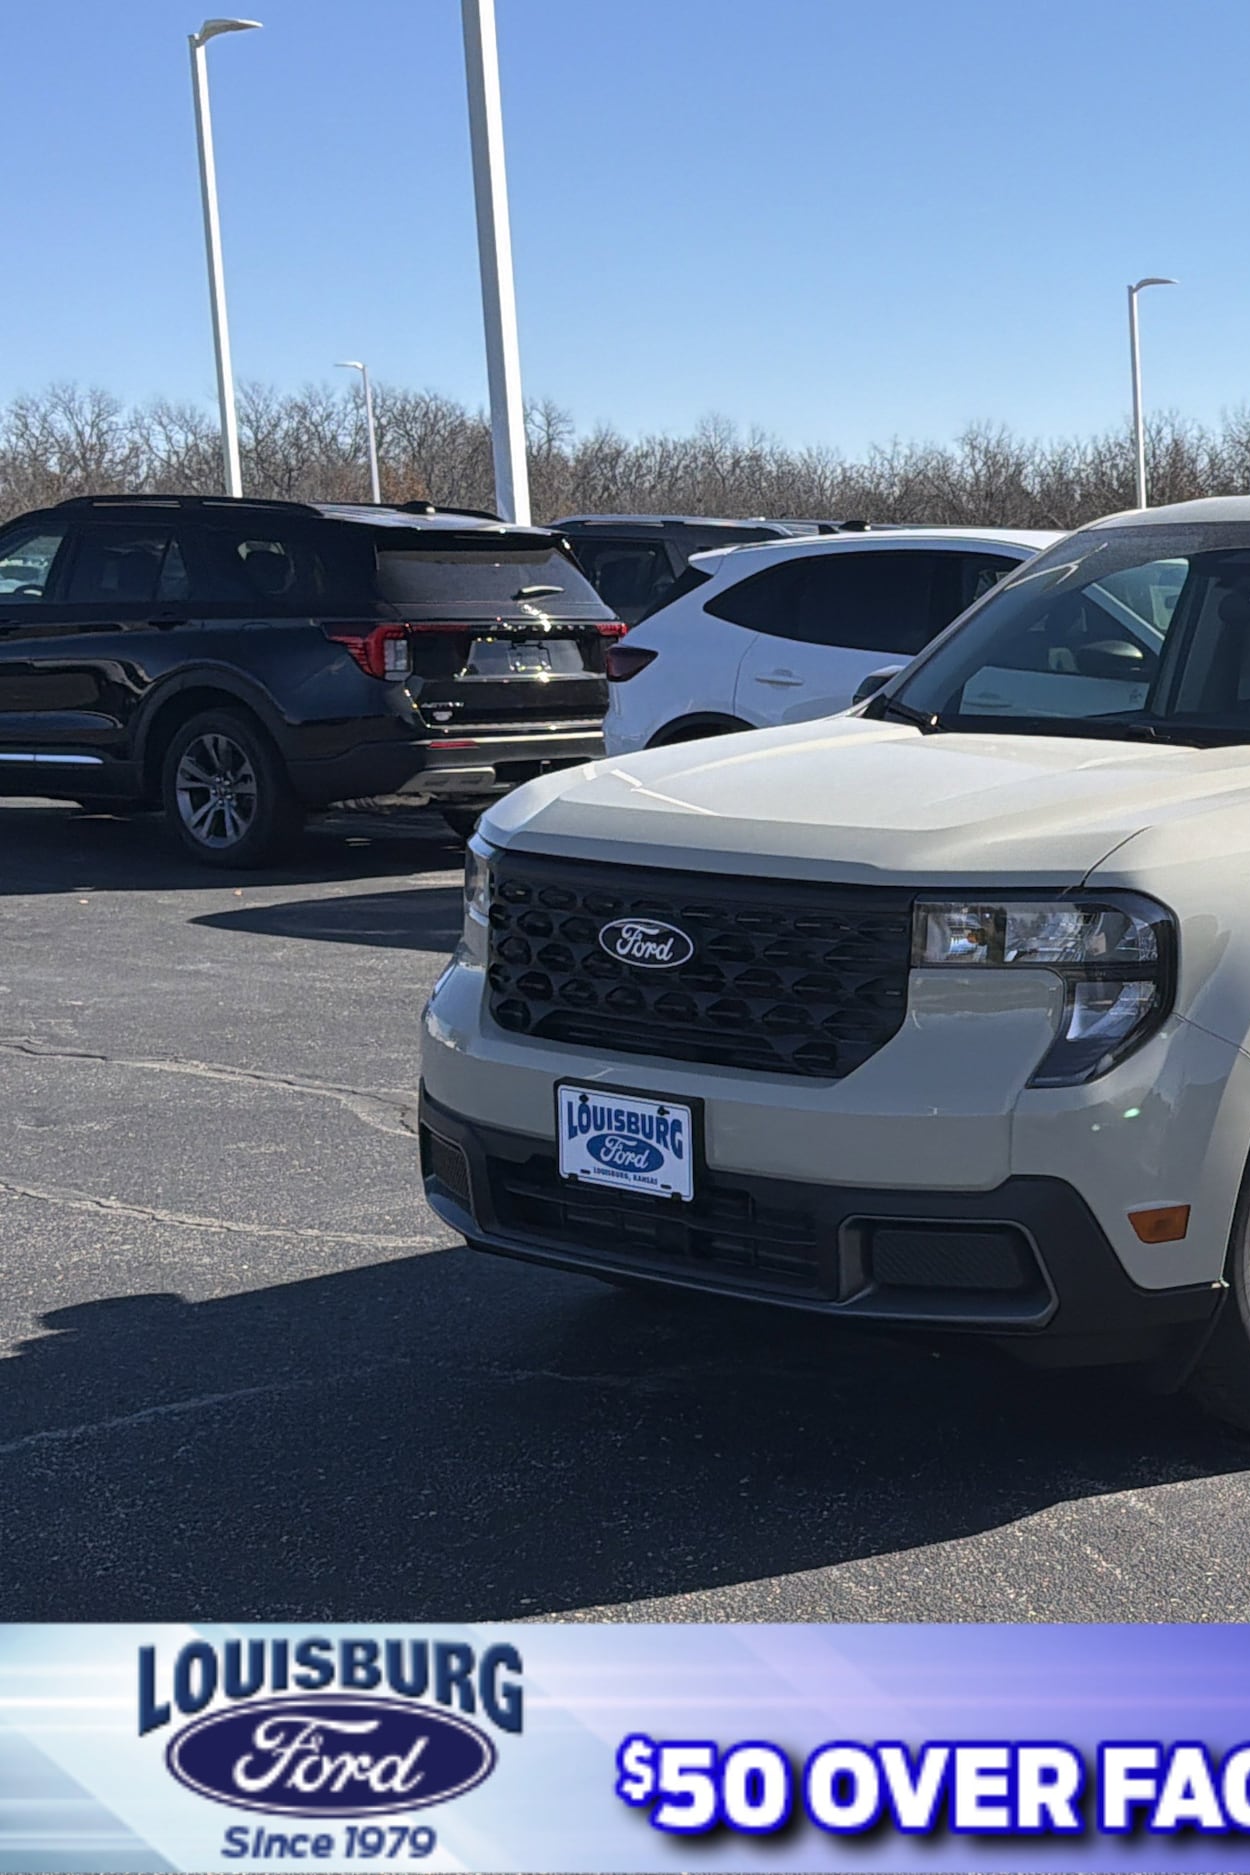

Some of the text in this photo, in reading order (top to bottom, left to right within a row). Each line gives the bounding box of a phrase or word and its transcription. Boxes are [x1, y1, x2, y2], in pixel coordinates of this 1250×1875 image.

[616, 923, 675, 961] Ford
[567, 1101, 684, 1160] LOUISBURG
[600, 1135, 650, 1169] Ford
